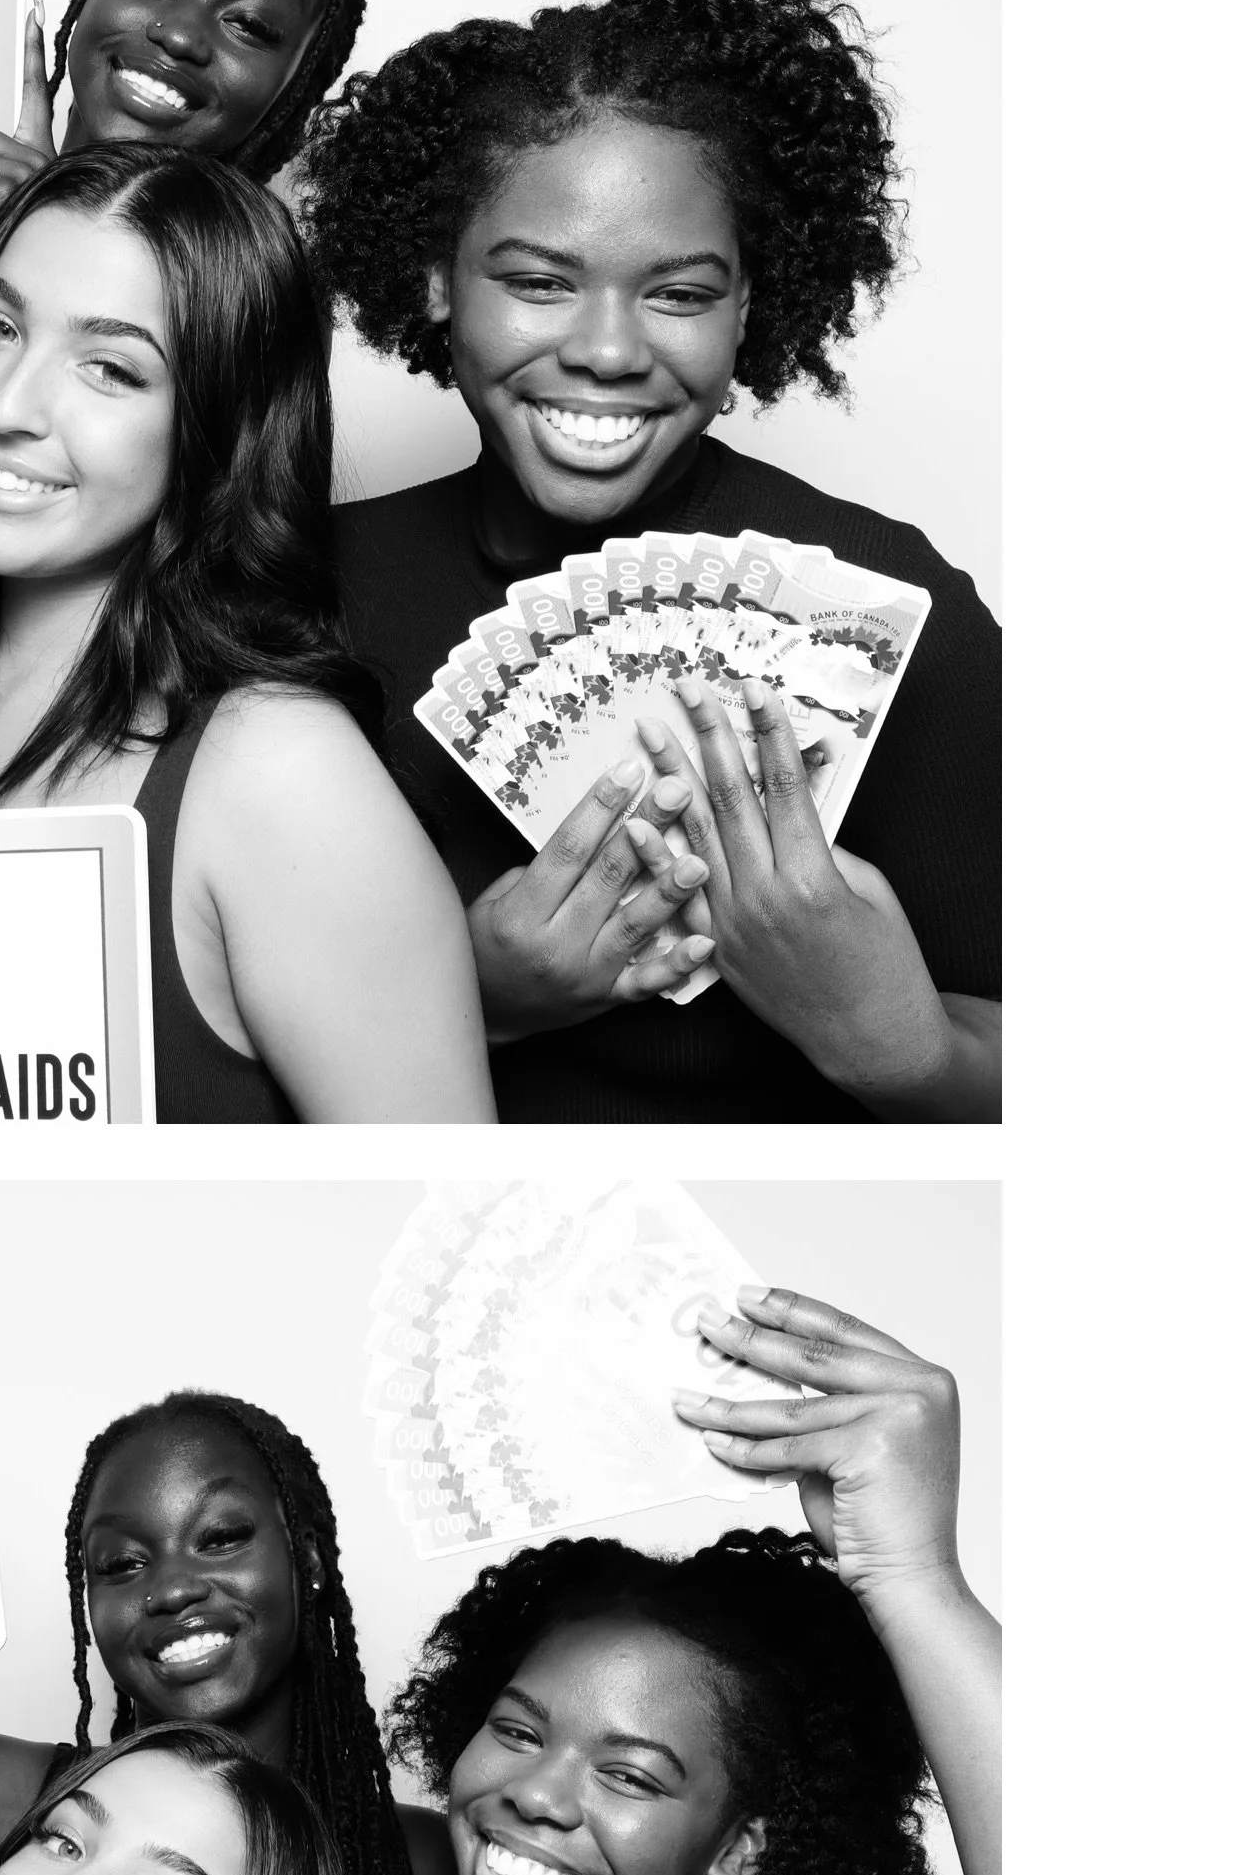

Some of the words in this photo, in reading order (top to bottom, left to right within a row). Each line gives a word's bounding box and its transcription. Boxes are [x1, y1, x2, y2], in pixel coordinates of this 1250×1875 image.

[618, 561, 641, 596] 100
[655, 556, 678, 592] 100
[695, 557, 725, 595] 100
[739, 559, 771, 597] 100
[582, 578, 605, 614] 100
[532, 598, 560, 641] 100
[810, 611, 838, 622] BANK
[841, 610, 855, 618] OF
[857, 612, 890, 629] CANADA
[495, 630, 526, 672] 100
[555, 637, 566, 645] 100
[522, 666, 532, 675] 100
[733, 701, 745, 710] DU
[441, 705, 474, 745] 100
